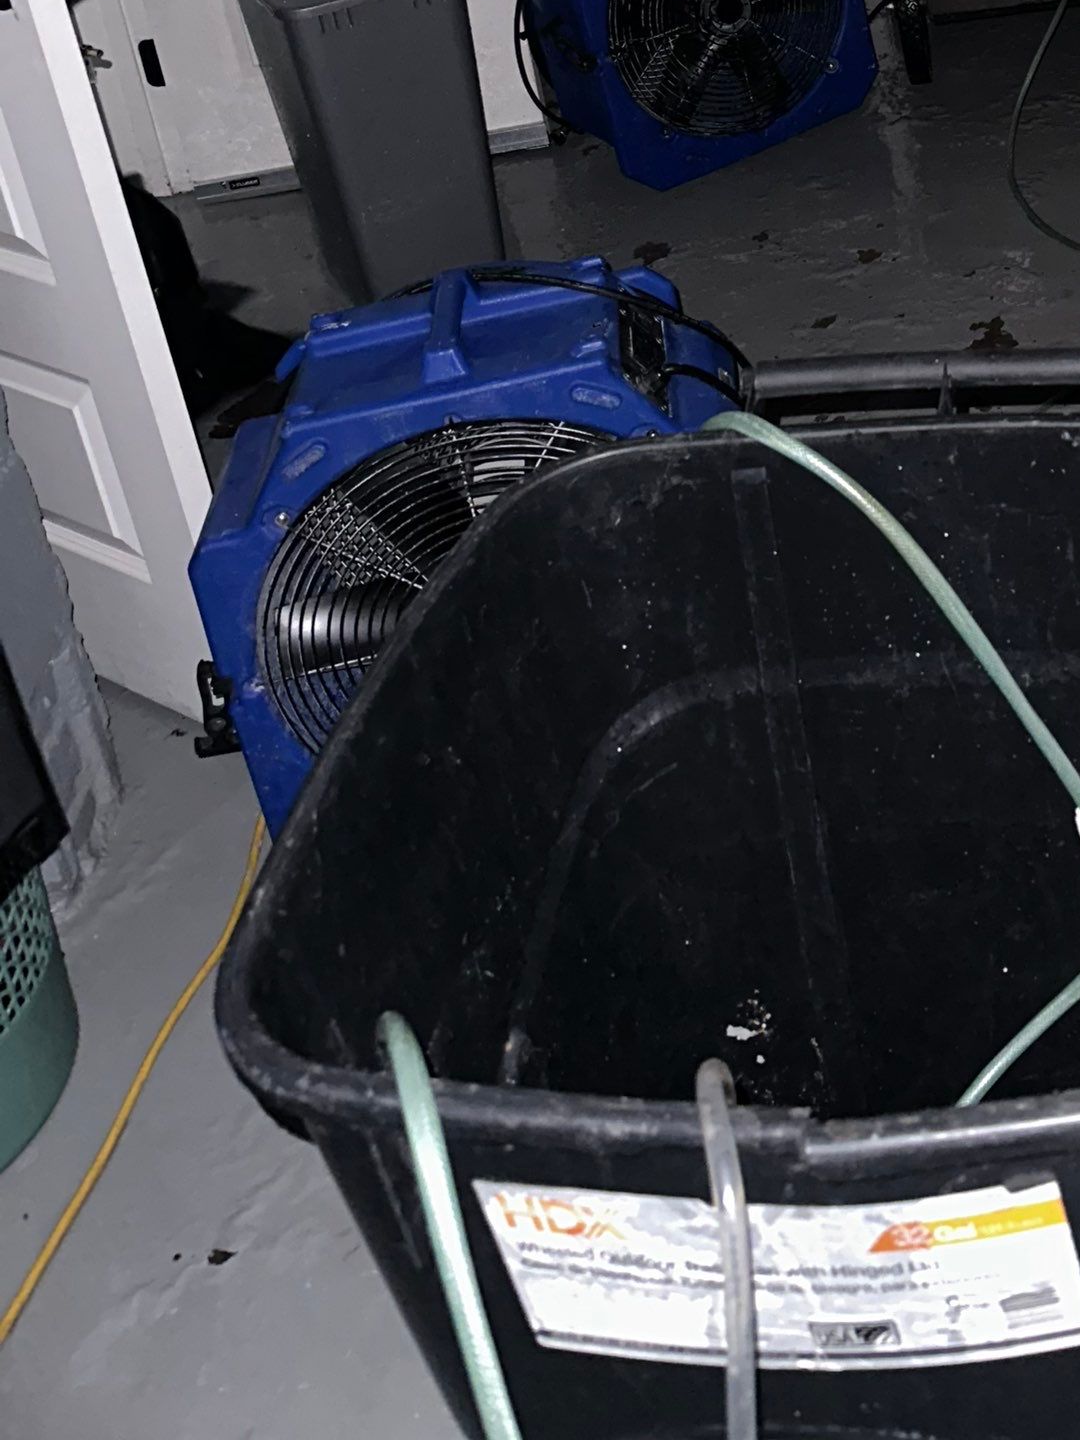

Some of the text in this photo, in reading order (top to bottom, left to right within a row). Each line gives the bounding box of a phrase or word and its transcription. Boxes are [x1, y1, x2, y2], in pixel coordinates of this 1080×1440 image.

[497, 1191, 629, 1241] HDX
[893, 1224, 932, 1249] 32
[933, 1220, 977, 1243] Gal
[831, 1259, 905, 1281] Hinged
